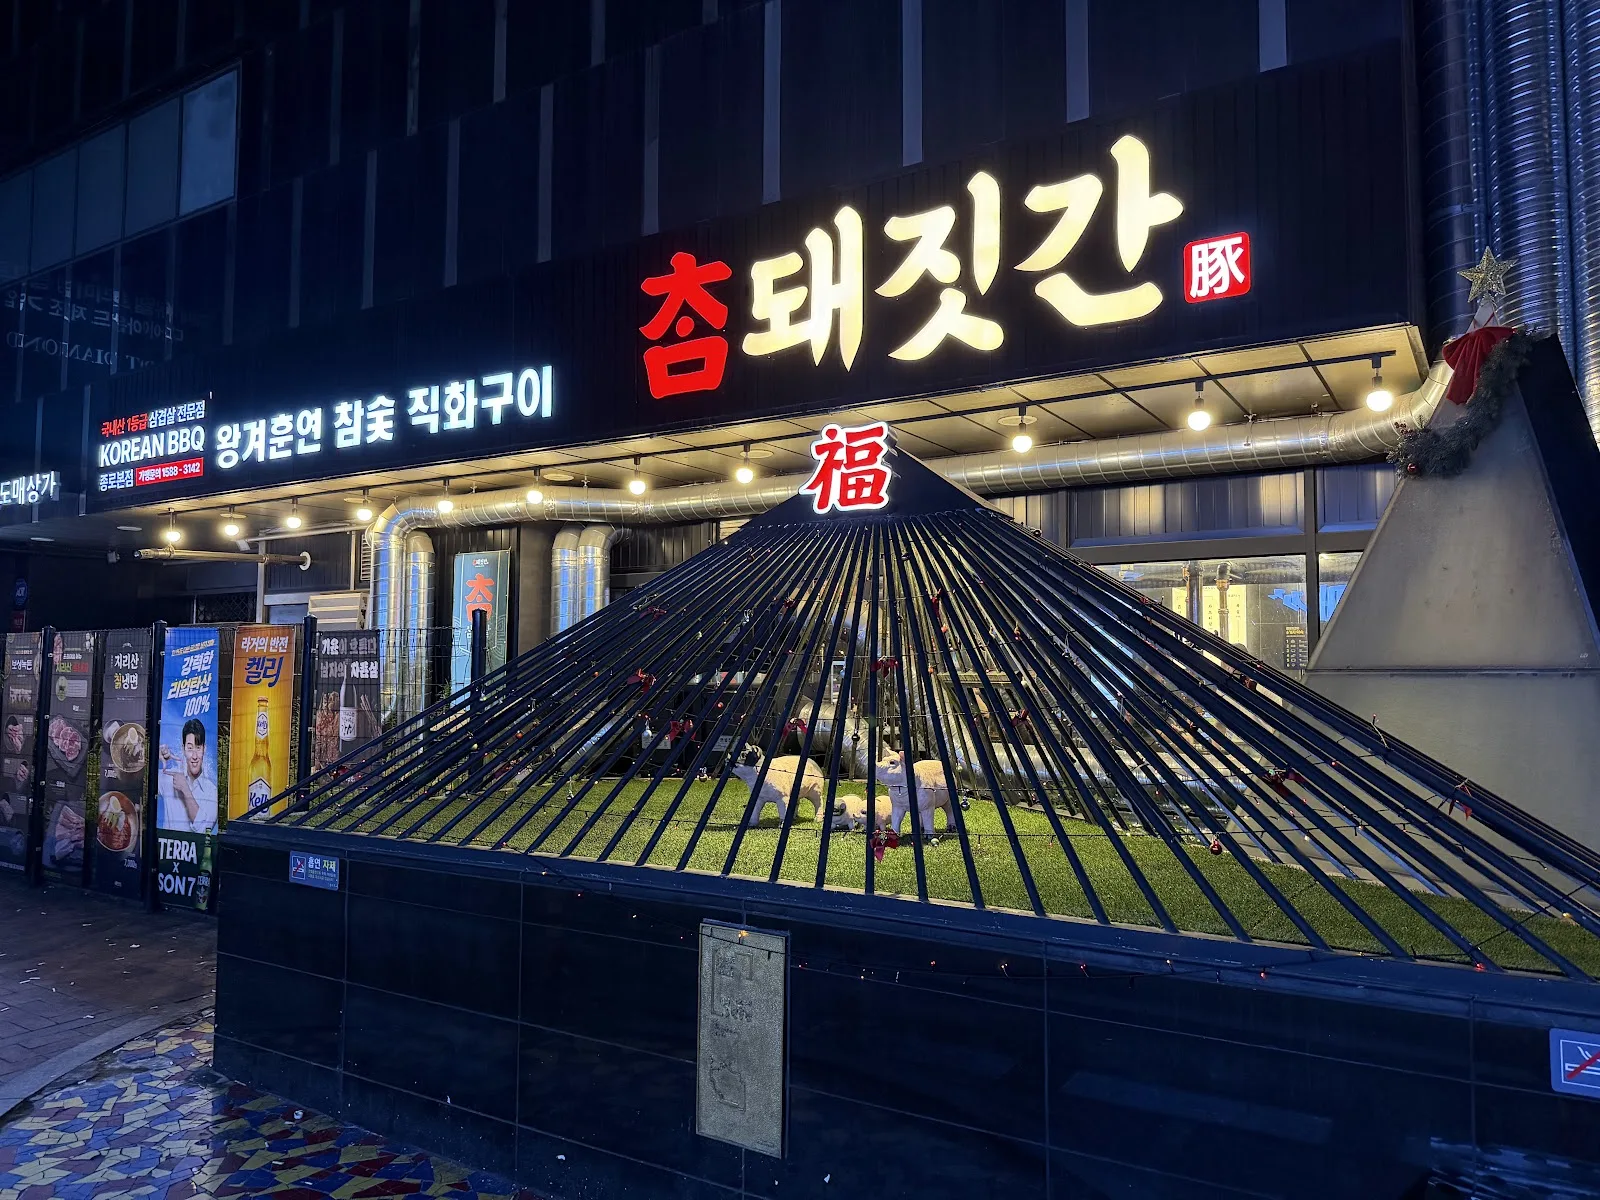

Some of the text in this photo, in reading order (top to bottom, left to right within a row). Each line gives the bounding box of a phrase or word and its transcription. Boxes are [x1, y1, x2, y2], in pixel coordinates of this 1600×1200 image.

[1188, 236, 1248, 300] 豚
[101, 400, 206, 438] 국내산 1등급 삼겹살 전문점
[215, 364, 554, 470] 왕겨훈연 참숯 직화구이
[100, 425, 206, 468] KOREAN BBQ
[99, 468, 135, 492] 종로본점
[800, 421, 893, 515] 福
[0, 470, 57, 505] 도매상가
[241, 636, 289, 653] 라거의 반전
[114, 652, 139, 670] 지리산
[181, 649, 215, 677] 강력한
[244, 655, 285, 688] 켈리
[113, 672, 139, 690] 칡냉면
[166, 671, 213, 700] 리얼탄산
[183, 693, 211, 718] 100%
[157, 837, 198, 865] TERRA
[307, 856, 336, 873] 흡연 자제
